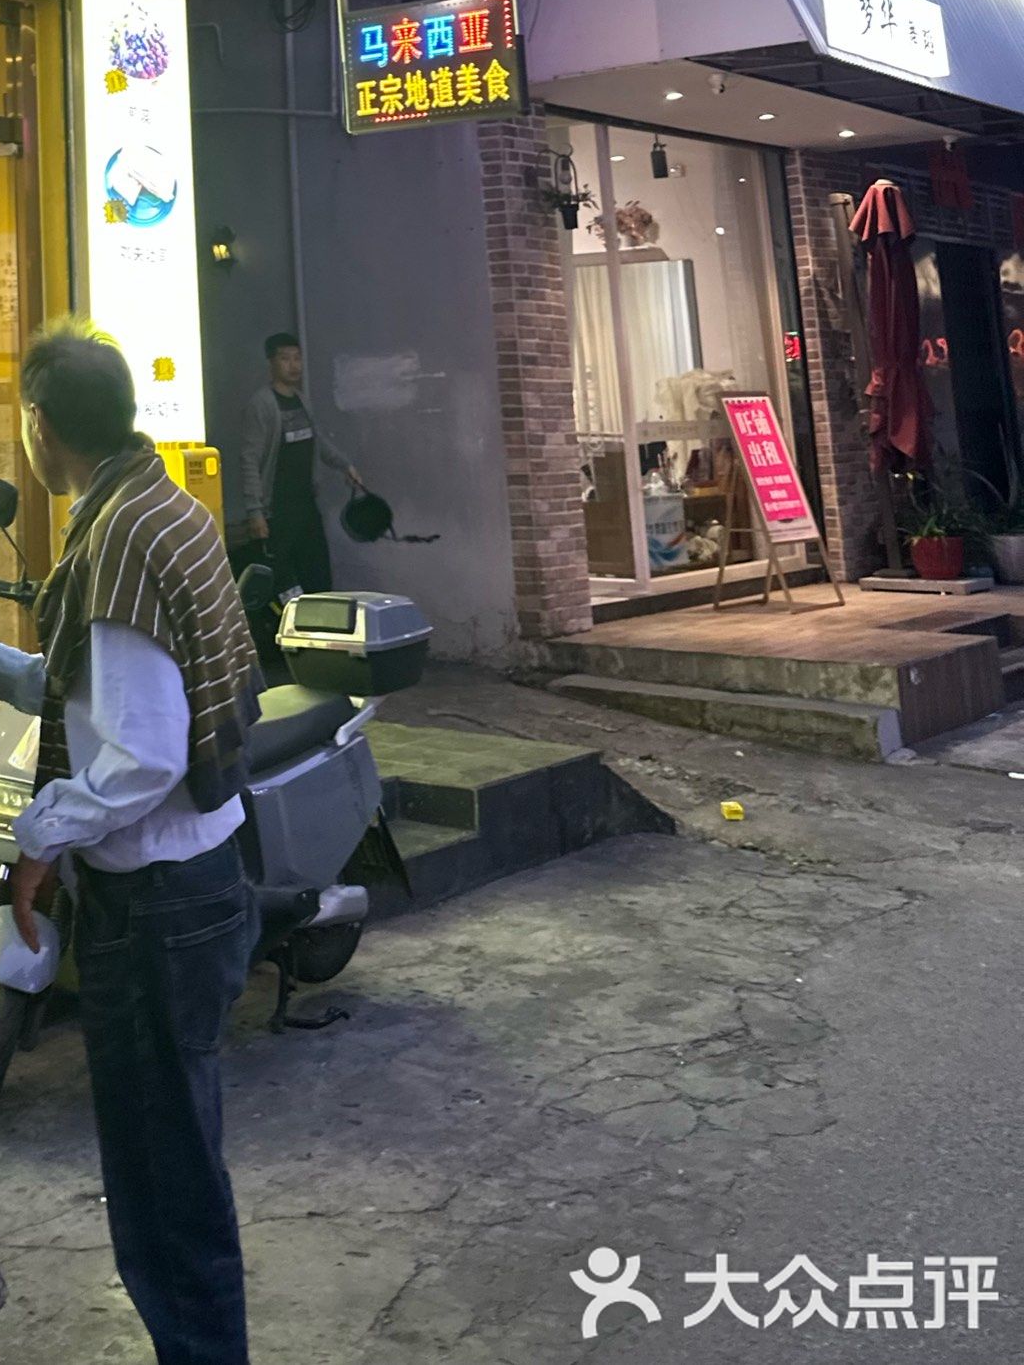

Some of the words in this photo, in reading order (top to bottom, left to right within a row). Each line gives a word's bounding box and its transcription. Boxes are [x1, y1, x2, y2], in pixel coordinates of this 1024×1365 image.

[359, 9, 494, 68] 马来西亚
[355, 58, 511, 117] 正宗地道美食
